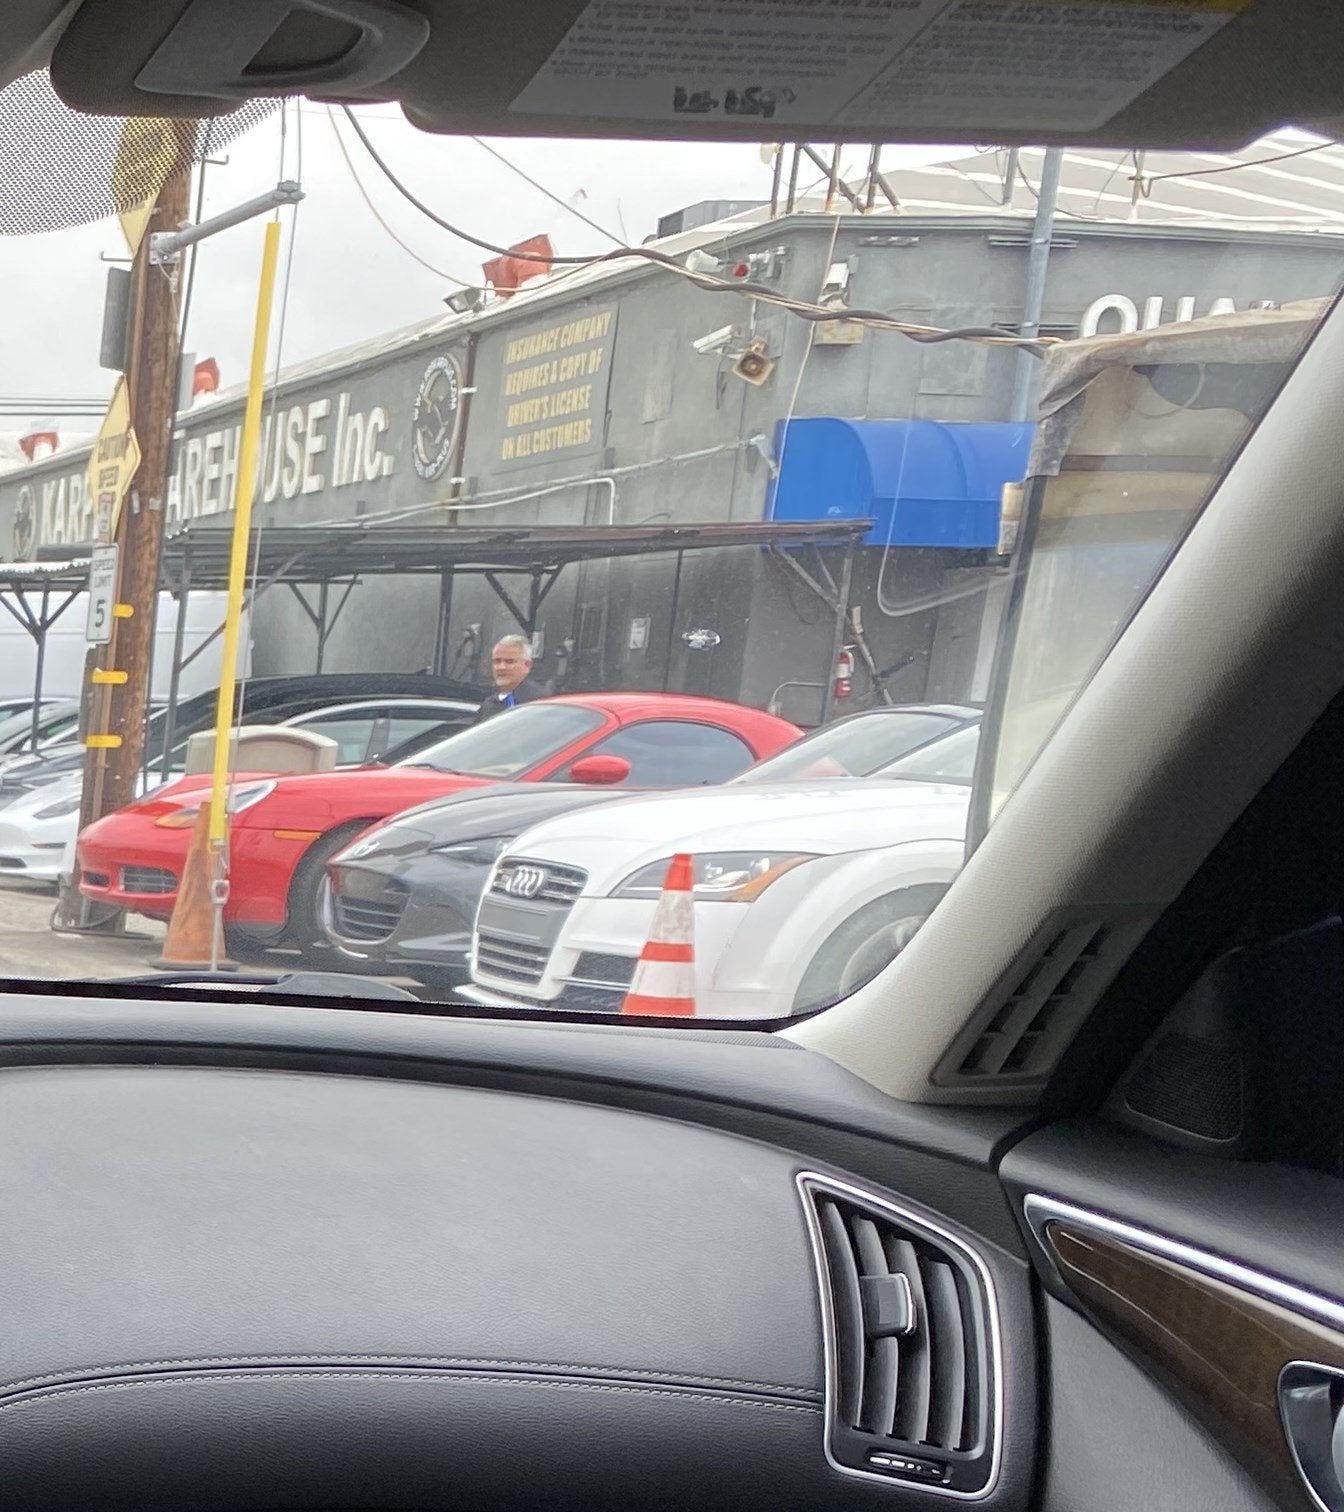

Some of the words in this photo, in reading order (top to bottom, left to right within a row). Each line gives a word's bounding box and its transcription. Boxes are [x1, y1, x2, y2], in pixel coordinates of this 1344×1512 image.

[560, 311, 612, 348] COMPANY
[559, 352, 587, 382] COPY
[588, 348, 603, 374] OF
[332, 391, 395, 487] Inc.
[532, 418, 593, 454] CUSTOMERS
[95, 599, 106, 628] 5
